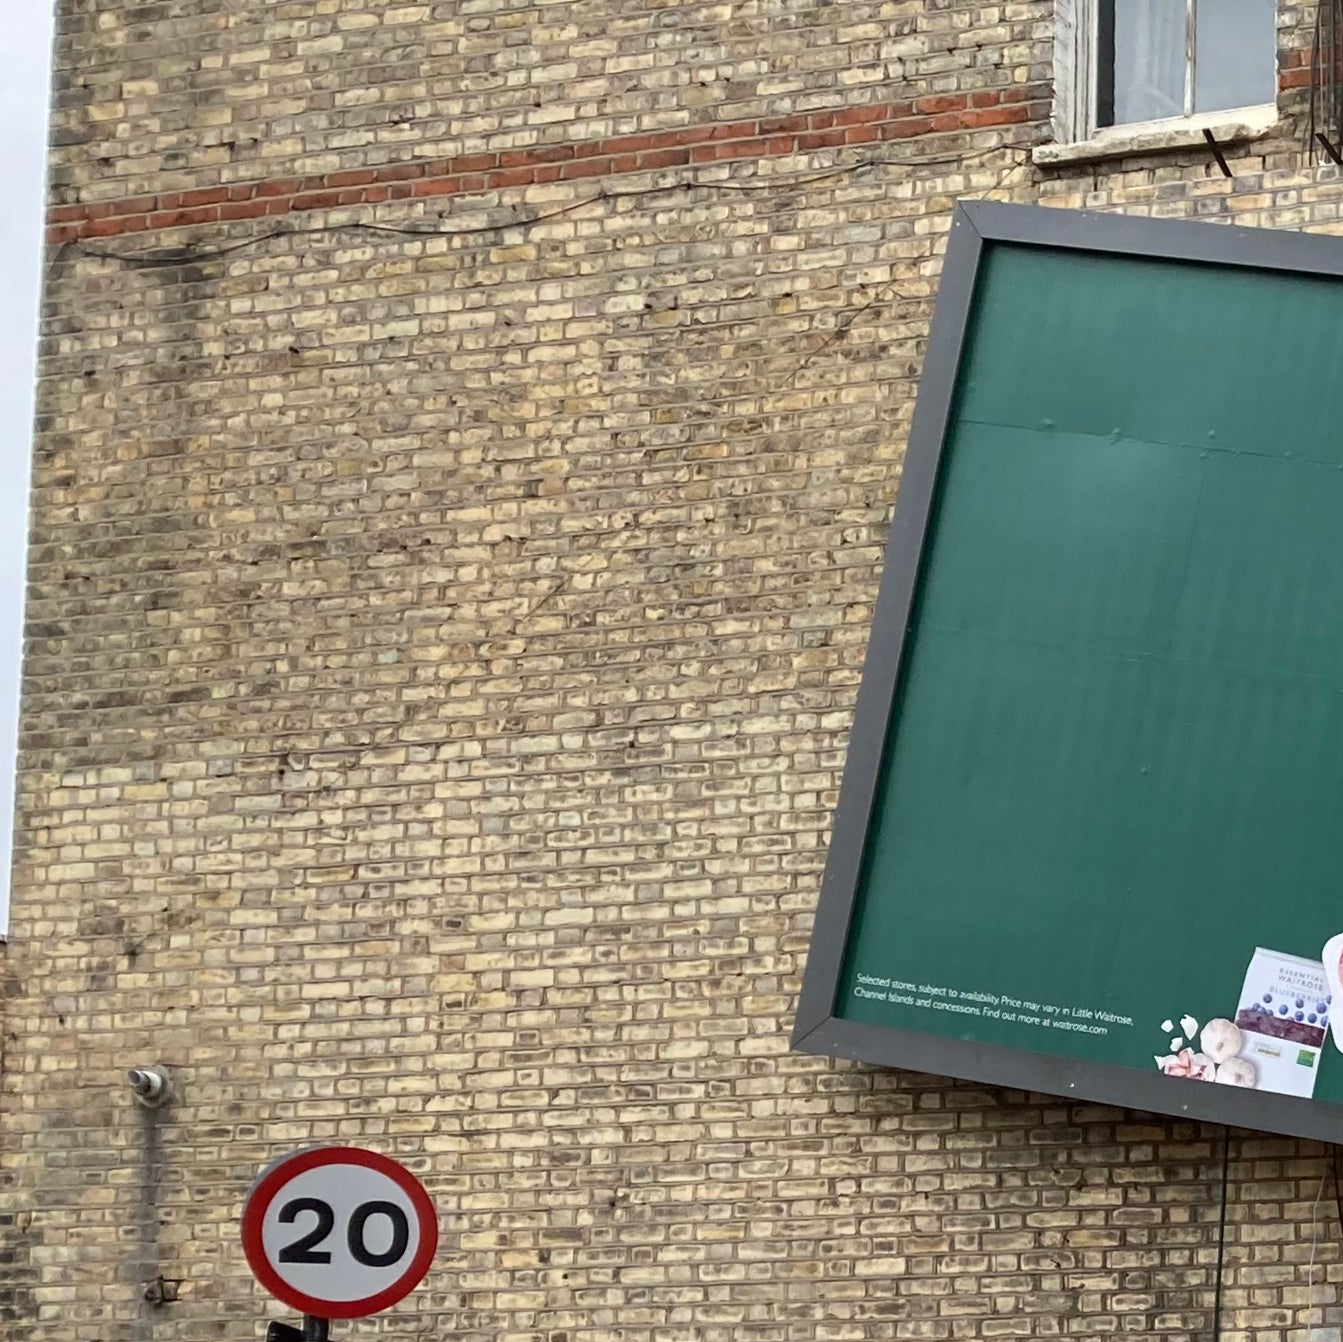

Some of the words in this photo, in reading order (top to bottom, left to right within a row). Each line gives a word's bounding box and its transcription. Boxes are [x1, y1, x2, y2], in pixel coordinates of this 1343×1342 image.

[856, 972, 891, 988] Selected
[918, 984, 947, 997] subject
[948, 988, 958, 998] to
[1001, 995, 1022, 1008] Price
[1023, 1001, 1041, 1013] may
[1042, 1004, 1060, 1017] vary
[1072, 1007, 1093, 1019] Little
[1278, 974, 1323, 992] WAITROSE
[1279, 968, 1324, 984] ESSENTIAL
[854, 986, 886, 1001] Channel
[887, 992, 914, 1005] Islands
[915, 999, 932, 1009] and
[983, 1006, 1001, 1019] Find
[1001, 1011, 1016, 1021] out
[1017, 1014, 1040, 1026] more
[1052, 1019, 1109, 1036] waitrose.com
[278, 1197, 409, 1268] 20
